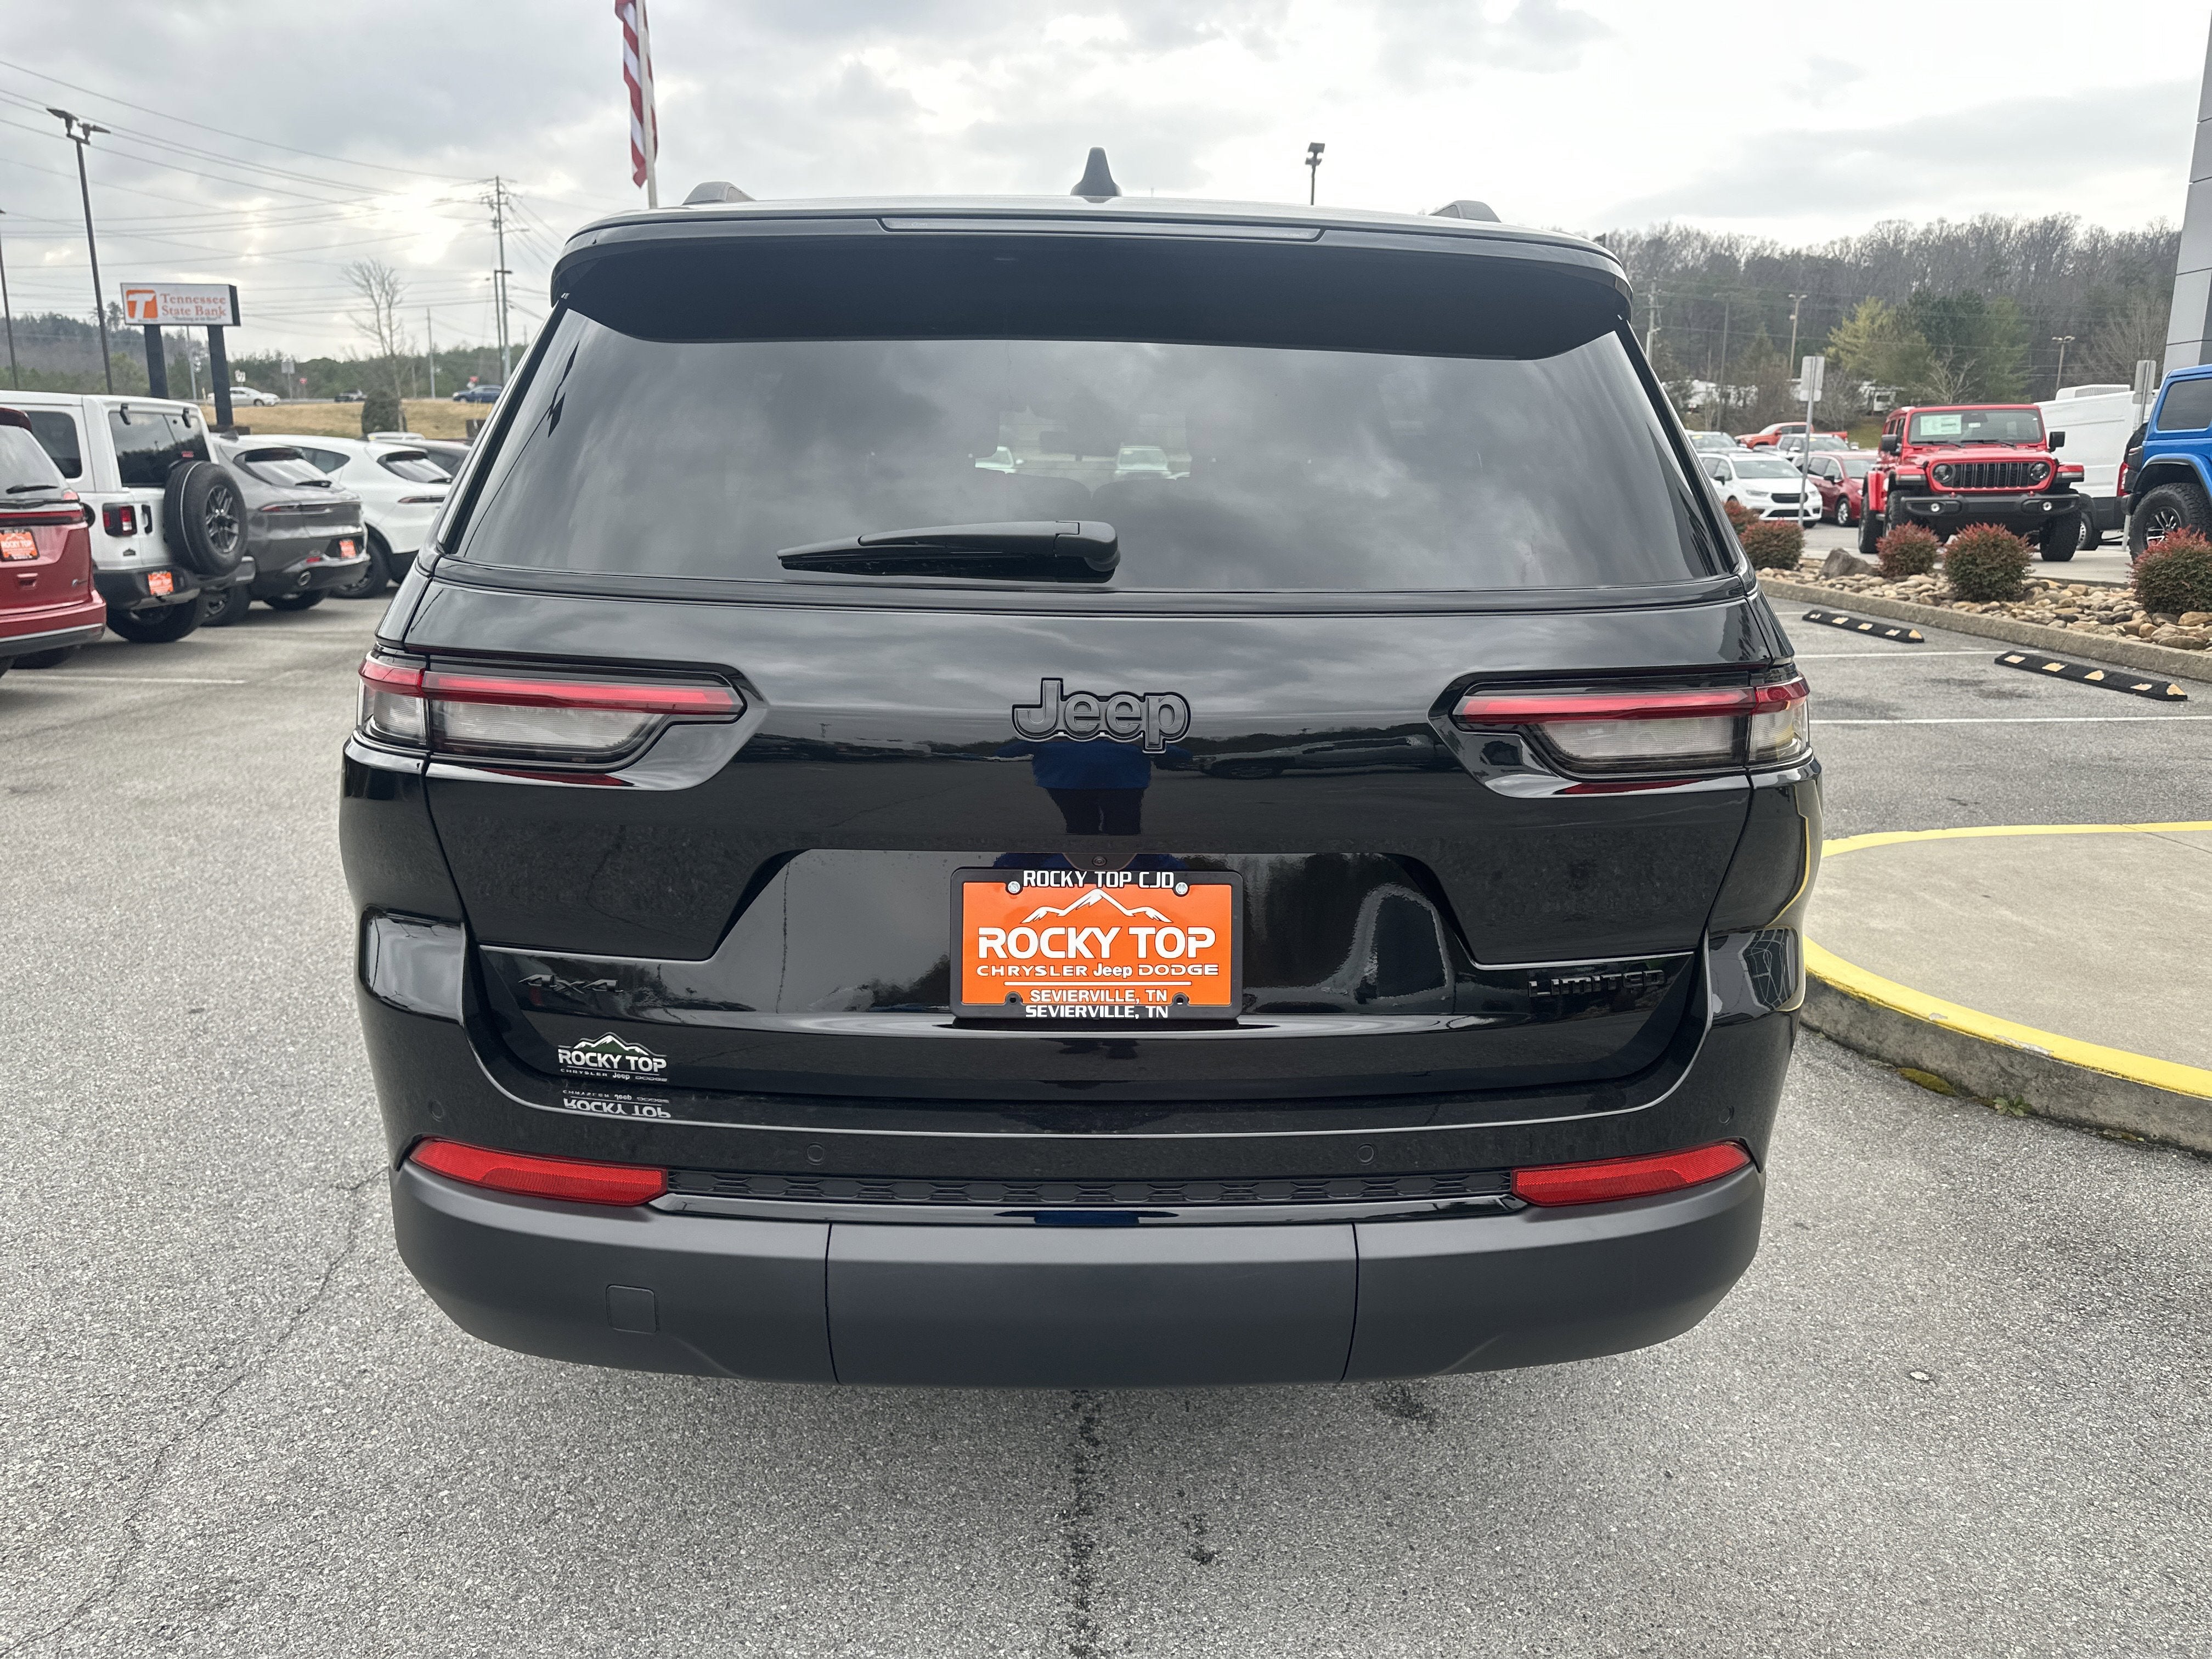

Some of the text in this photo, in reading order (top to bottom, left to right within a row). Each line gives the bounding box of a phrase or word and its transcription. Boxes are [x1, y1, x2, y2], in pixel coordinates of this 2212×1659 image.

[160, 294, 226, 304] Tennessee
[161, 305, 227, 317] State Bank
[1012, 678, 1192, 753] Jeep
[1023, 870, 1175, 889] ROCKY TOP CJD
[978, 926, 1216, 960] ROCKY TOP
[976, 963, 1219, 979] CHRYSLER Jeep DODGE
[1528, 969, 1665, 998] LIMITED
[1030, 989, 1167, 1005] SEVIERVILLE, TN
[1025, 1005, 1168, 1019] SEVIERVILLE, TN
[557, 1048, 667, 1073] ROCKY TOP
[560, 1068, 608, 1077] CHRYSLER
[612, 1071, 630, 1081] Jeep
